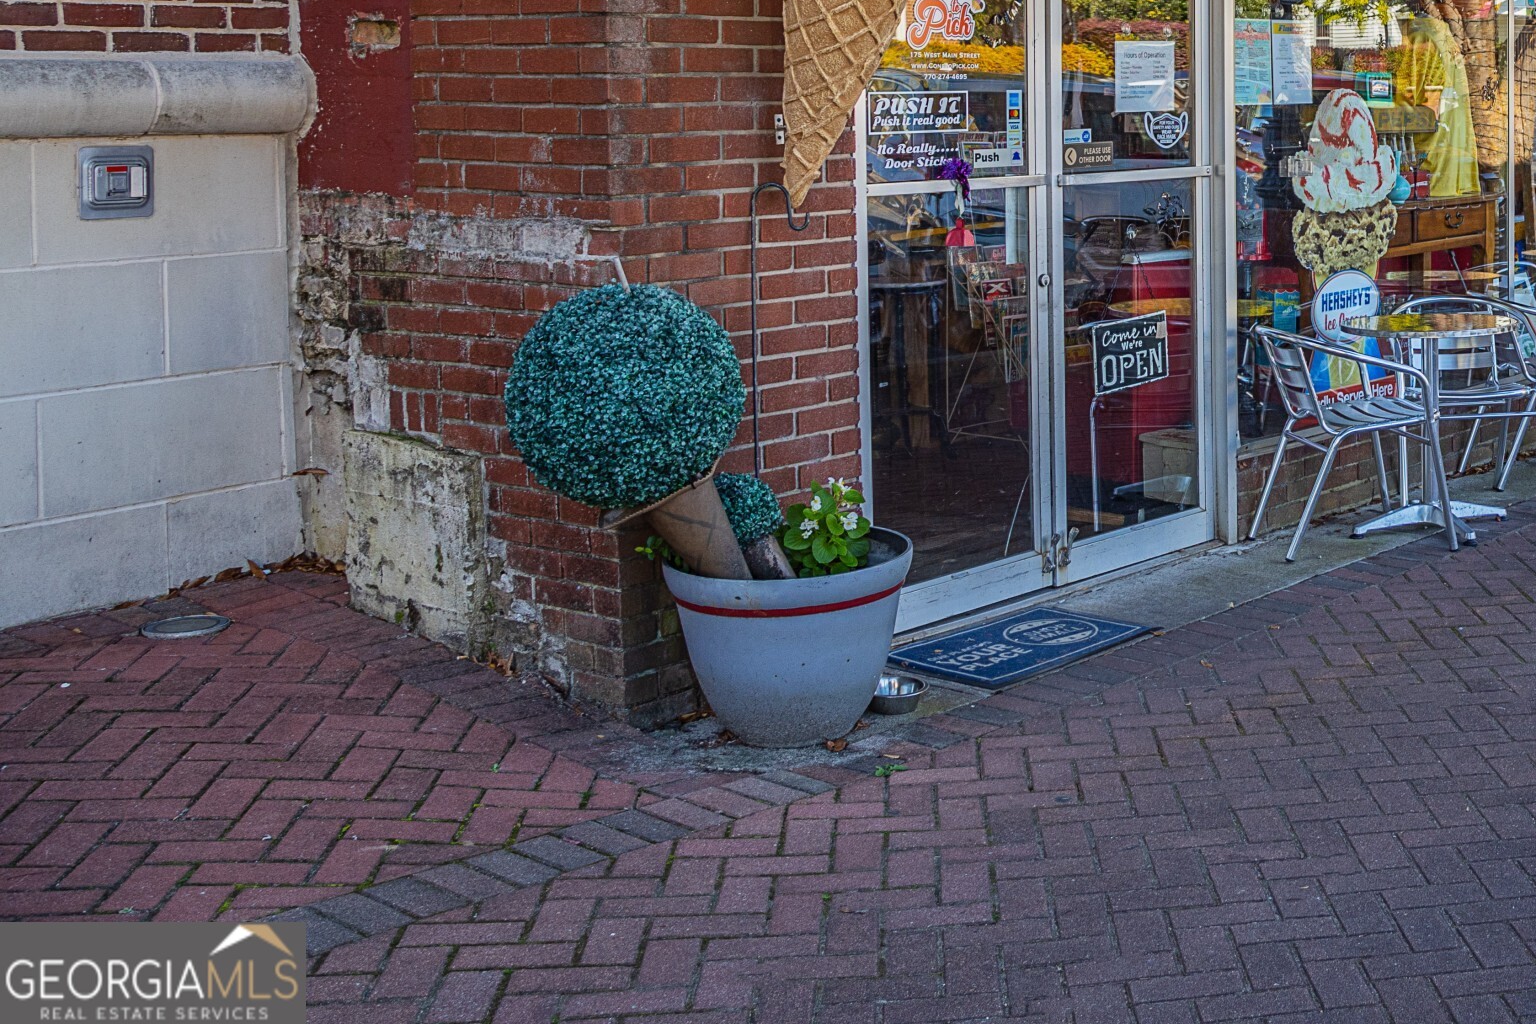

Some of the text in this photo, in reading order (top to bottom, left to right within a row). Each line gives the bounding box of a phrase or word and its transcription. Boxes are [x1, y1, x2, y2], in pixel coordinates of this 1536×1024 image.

[873, 96, 961, 115] PUSH IT
[873, 114, 961, 128] Push it real good
[877, 144, 895, 155] No
[975, 152, 999, 163] Push
[1084, 146, 1111, 155] PLEASE USE
[885, 158, 914, 169] Door
[1079, 156, 1094, 164] OTHER
[1322, 286, 1372, 312] HERSHEY'S
[1324, 314, 1337, 331] Ice
[1103, 321, 1157, 347] Come in
[1121, 340, 1143, 351] We're
[1101, 342, 1163, 387] OPEN
[1372, 382, 1393, 397] Here
[1029, 626, 1085, 643] SMALL
[935, 643, 1014, 666] YOUR
[958, 647, 1033, 672] PLACE
